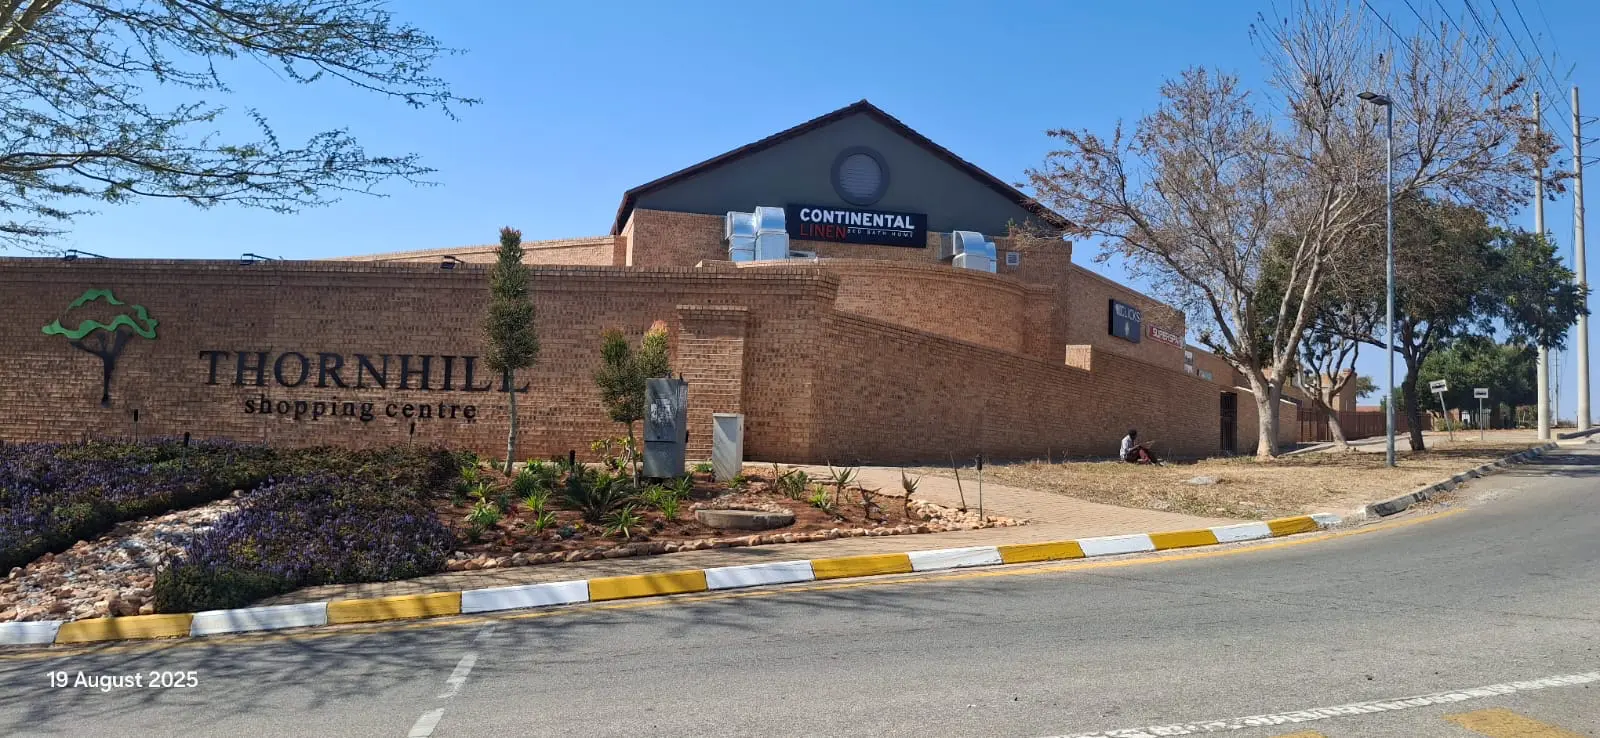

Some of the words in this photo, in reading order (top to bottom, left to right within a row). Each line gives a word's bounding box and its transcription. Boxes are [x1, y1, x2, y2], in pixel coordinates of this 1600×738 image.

[799, 208, 916, 230] CONTINENTAL
[799, 223, 849, 240] LINEN
[199, 350, 531, 394] THORNHILL
[244, 394, 375, 422] shopping
[385, 401, 477, 419] centre
